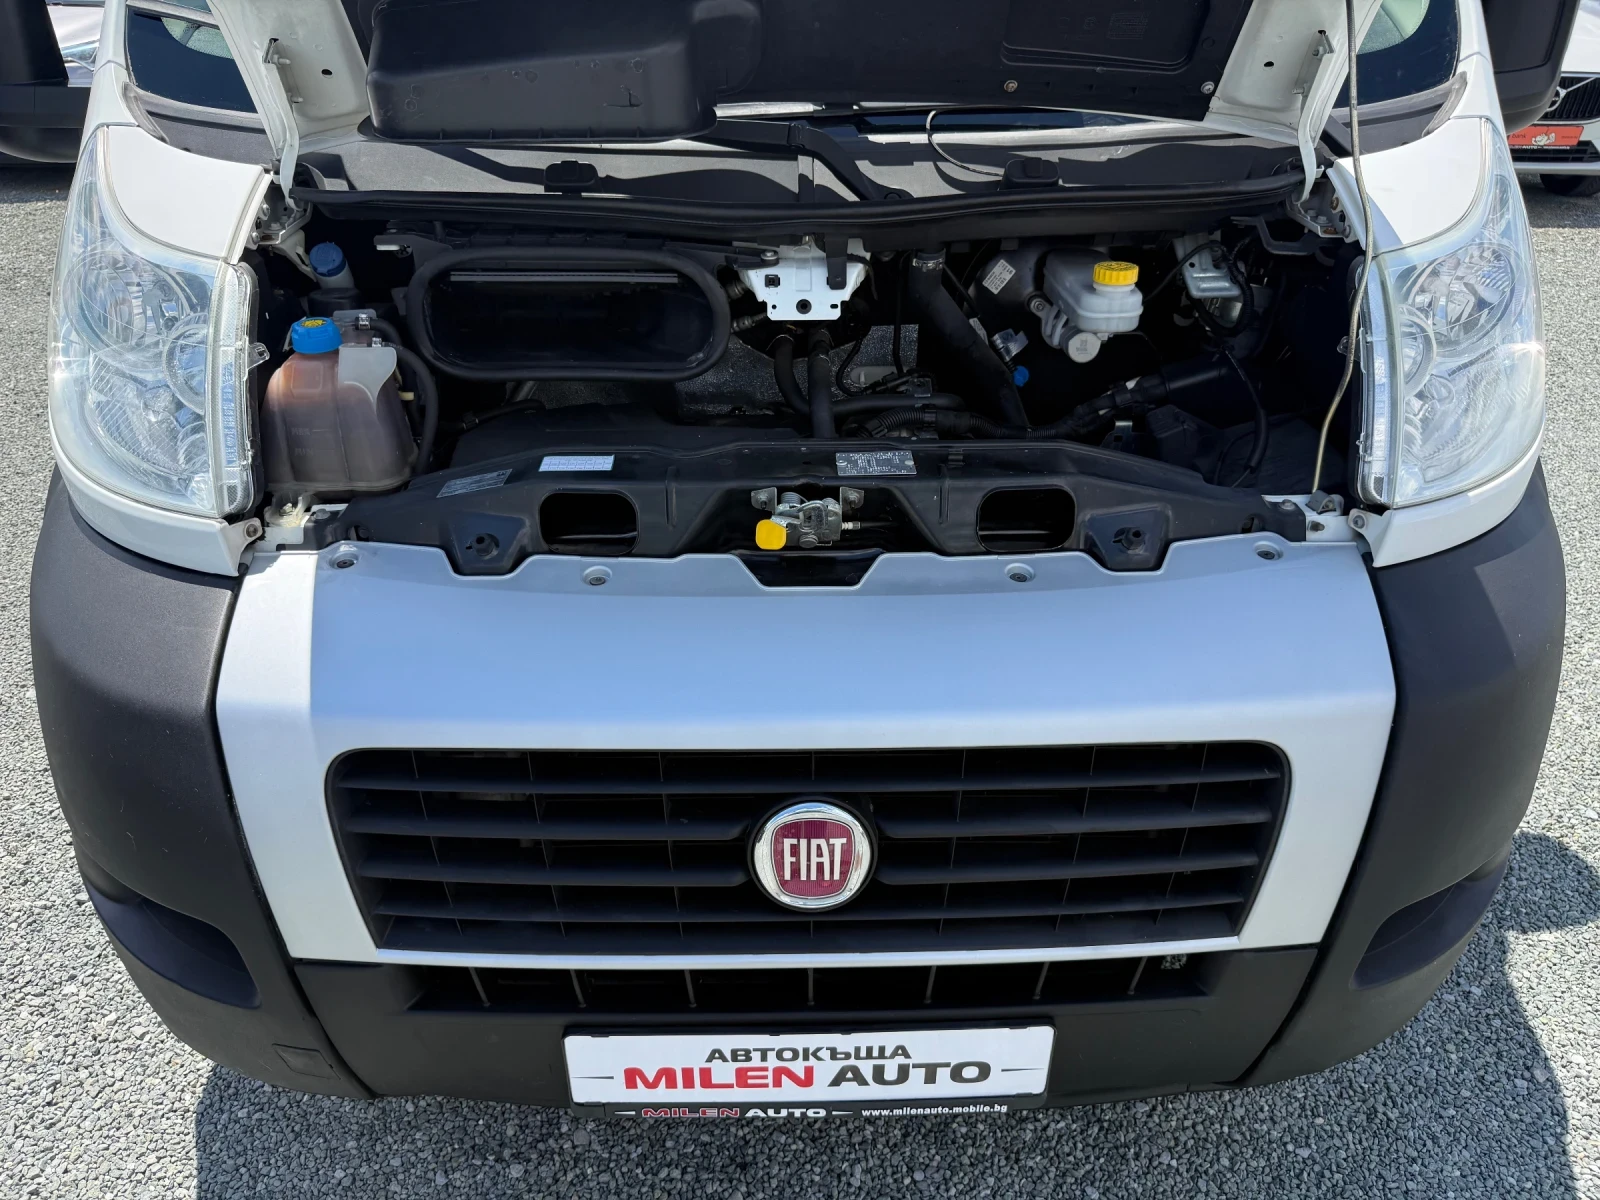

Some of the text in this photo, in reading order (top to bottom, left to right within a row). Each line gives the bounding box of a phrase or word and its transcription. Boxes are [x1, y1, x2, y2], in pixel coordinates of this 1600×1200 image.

[783, 837, 847, 881] FIAT
[624, 1060, 992, 1090] MILEN AUTO
[642, 1103, 1008, 1118] MILEN AUTO www.milenauto.mobile.bg
